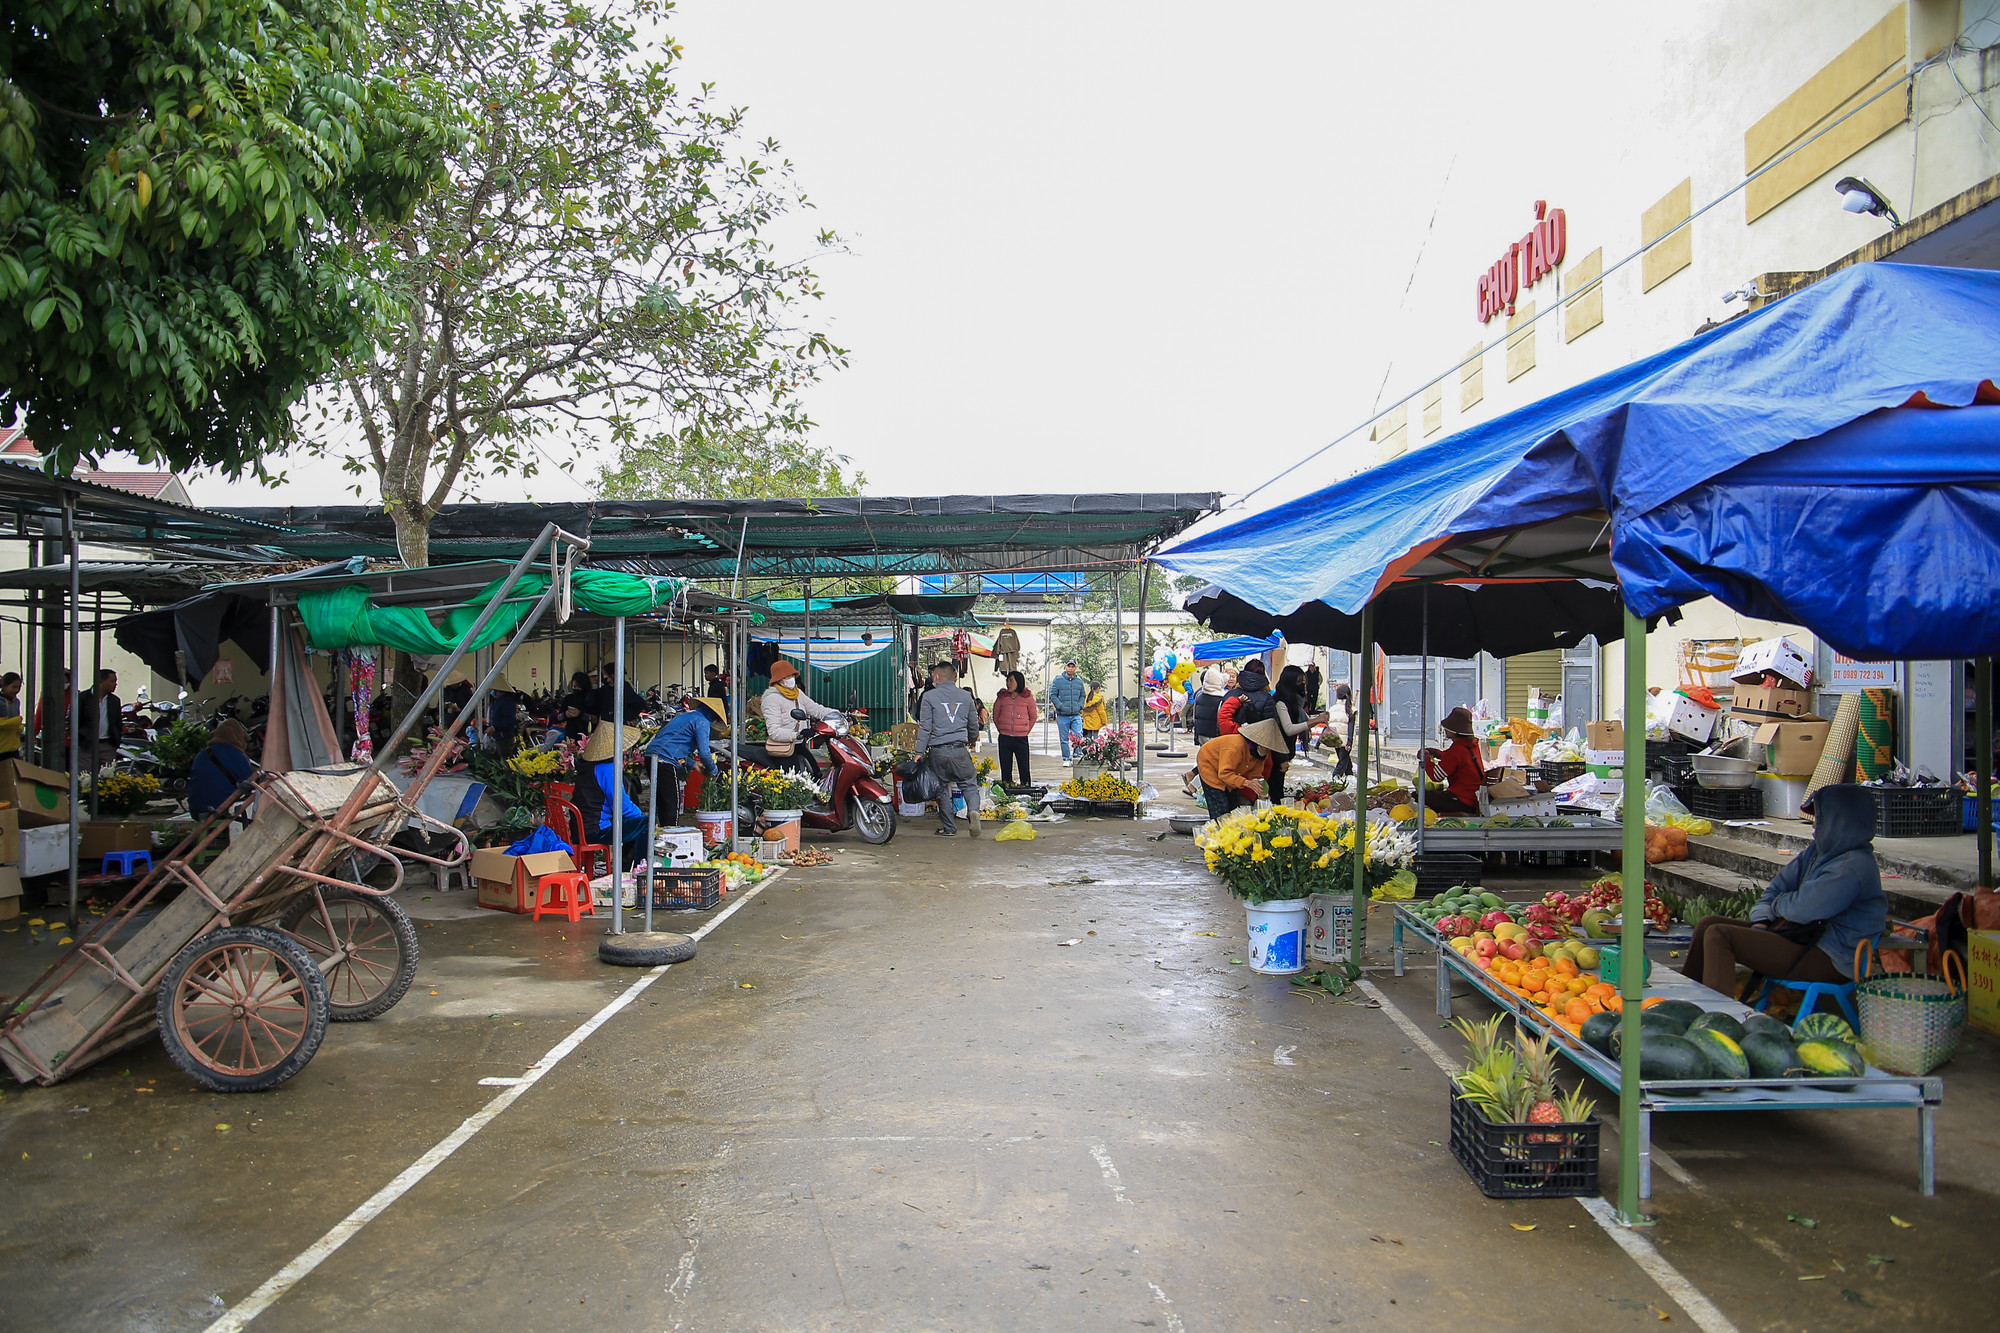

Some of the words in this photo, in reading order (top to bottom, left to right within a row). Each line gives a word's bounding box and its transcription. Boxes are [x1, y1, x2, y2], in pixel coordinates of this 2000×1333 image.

[1477, 243, 1519, 323] CHỢ
[1518, 200, 1566, 288] TẢO
[1860, 670, 1871, 680] 722
[940, 702, 964, 724] V
[1973, 971, 1994, 993] 3391
